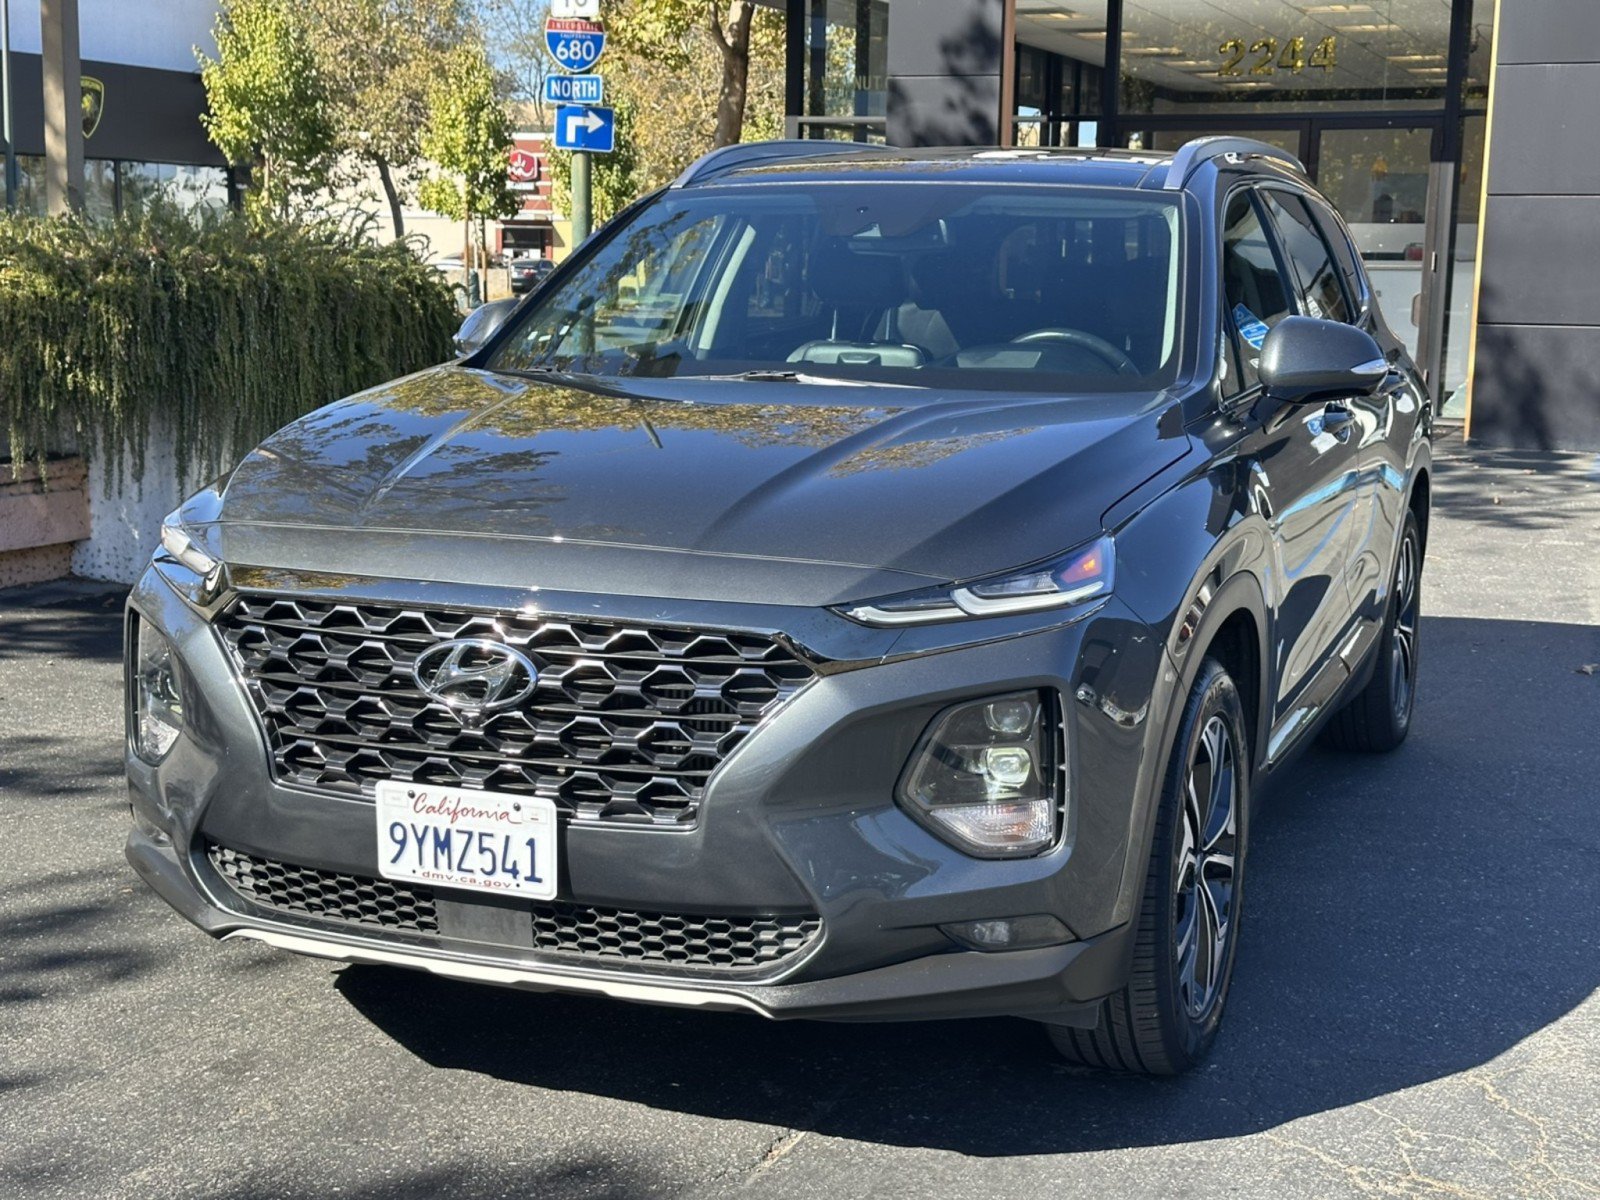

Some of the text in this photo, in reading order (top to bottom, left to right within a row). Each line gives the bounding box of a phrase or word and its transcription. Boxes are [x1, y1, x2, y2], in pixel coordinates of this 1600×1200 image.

[556, 40, 595, 61] 680
[1218, 36, 1337, 76] 2244
[551, 80, 598, 98] NORTH
[413, 792, 523, 824] California
[389, 821, 543, 884] 9YMZ541
[422, 870, 512, 889] dmv.ca.gov
